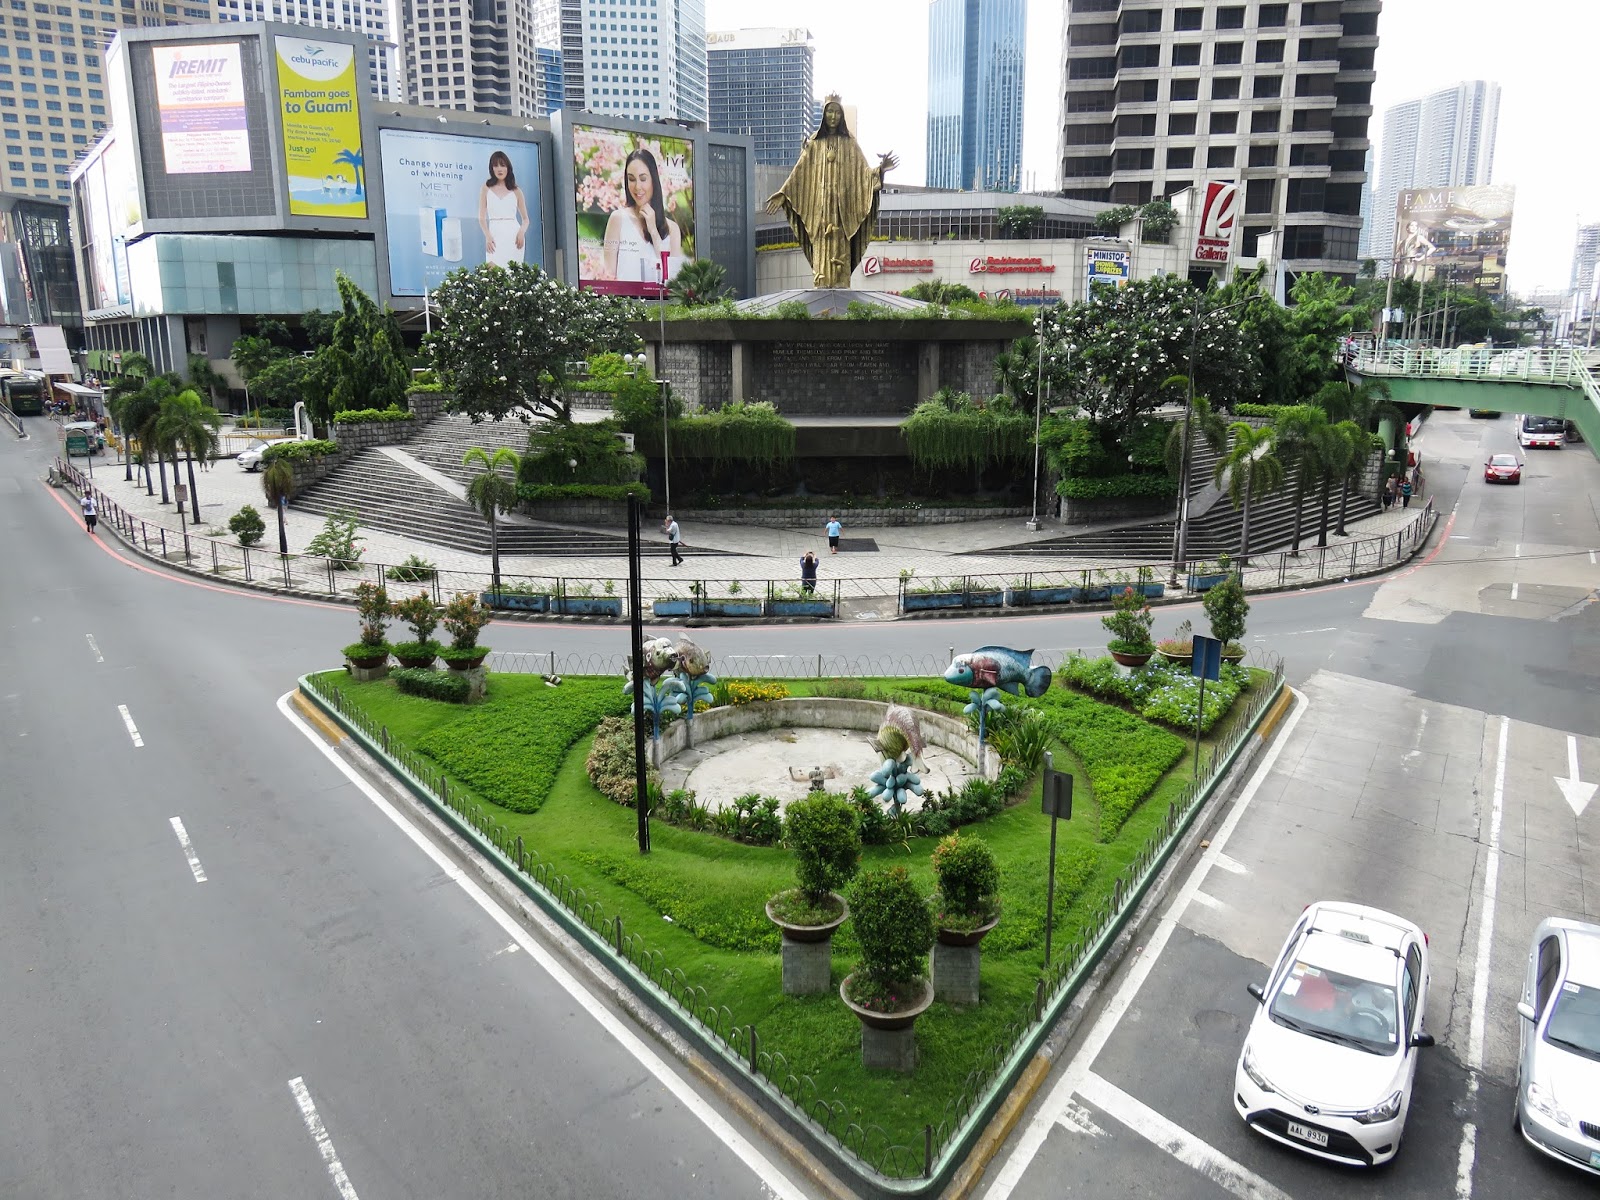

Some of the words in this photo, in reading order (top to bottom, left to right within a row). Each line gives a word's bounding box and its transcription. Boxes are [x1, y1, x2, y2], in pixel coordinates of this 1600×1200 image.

[291, 55, 311, 64] cebu
[312, 58, 339, 68] pacific
[283, 89, 326, 98] Fambam
[328, 91, 350, 100] goes
[285, 101, 301, 113] to
[304, 99, 353, 113] Guam!
[289, 144, 304, 152] Just
[304, 146, 317, 154] go!
[399, 157, 431, 168] Change
[434, 161, 453, 169] your
[455, 161, 473, 170] idea
[666, 152, 684, 168] ivi
[423, 170, 463, 181] whitening
[420, 182, 451, 191] MET
[1403, 191, 1455, 205] FAME
[1093, 251, 1125, 261] MINISTOP
[1195, 245, 1229, 261] Galleria
[883, 257, 934, 268] Robinsons
[987, 256, 1042, 265] Robinsons
[987, 264, 1056, 275] Supermarket
[1474, 276, 1501, 284] SMDC
[1290, 1124, 1304, 1136] AAL
[1306, 1130, 1327, 1143] 8930
